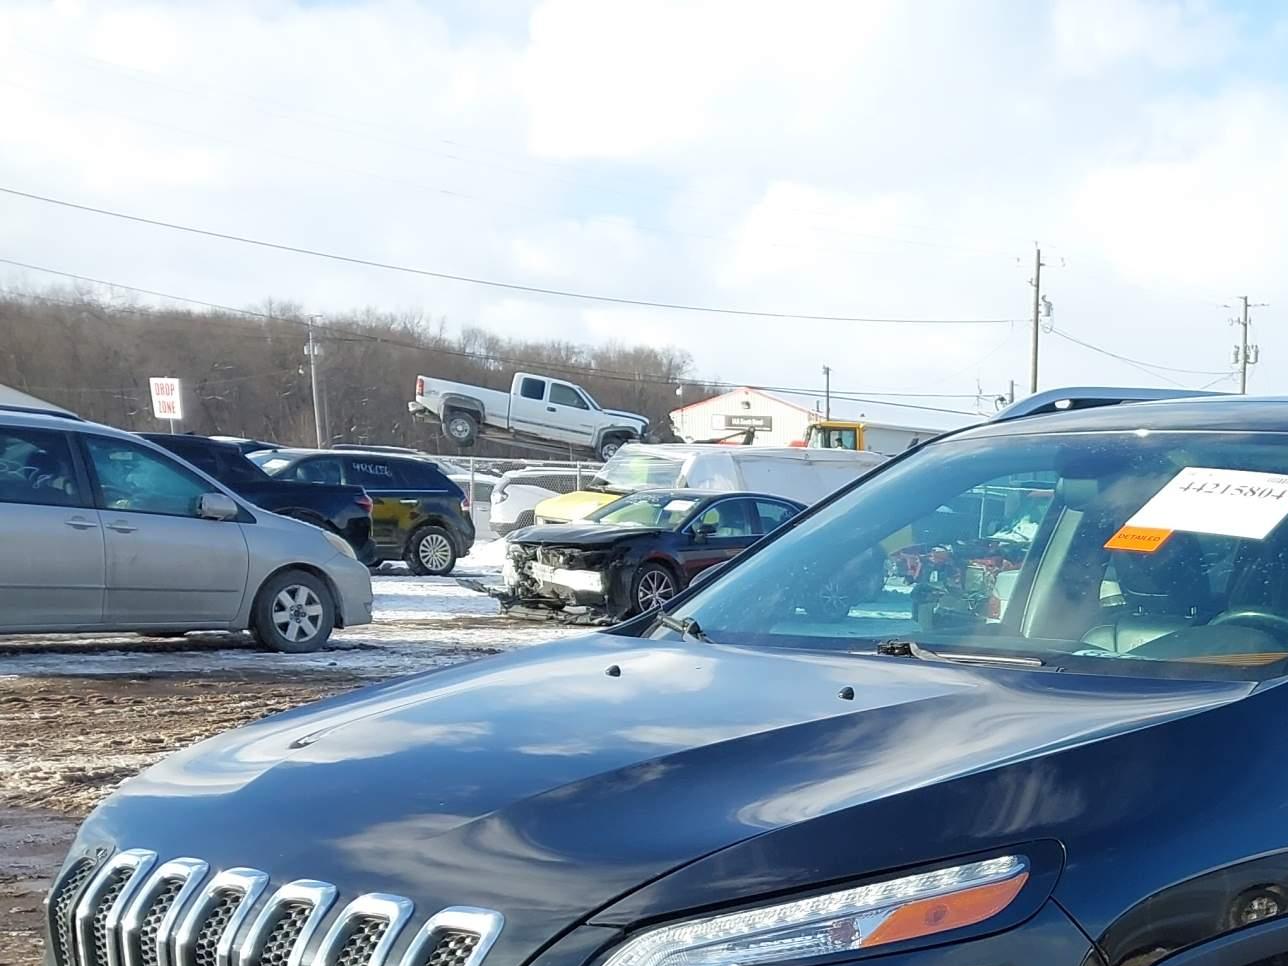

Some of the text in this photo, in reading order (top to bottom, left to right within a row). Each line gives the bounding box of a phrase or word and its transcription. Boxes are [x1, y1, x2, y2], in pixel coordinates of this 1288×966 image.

[154, 382, 175, 397] DROP
[157, 400, 176, 415] ZONE
[1179, 481, 1288, 500] 44215804
[1118, 533, 1161, 542] DETAILED
